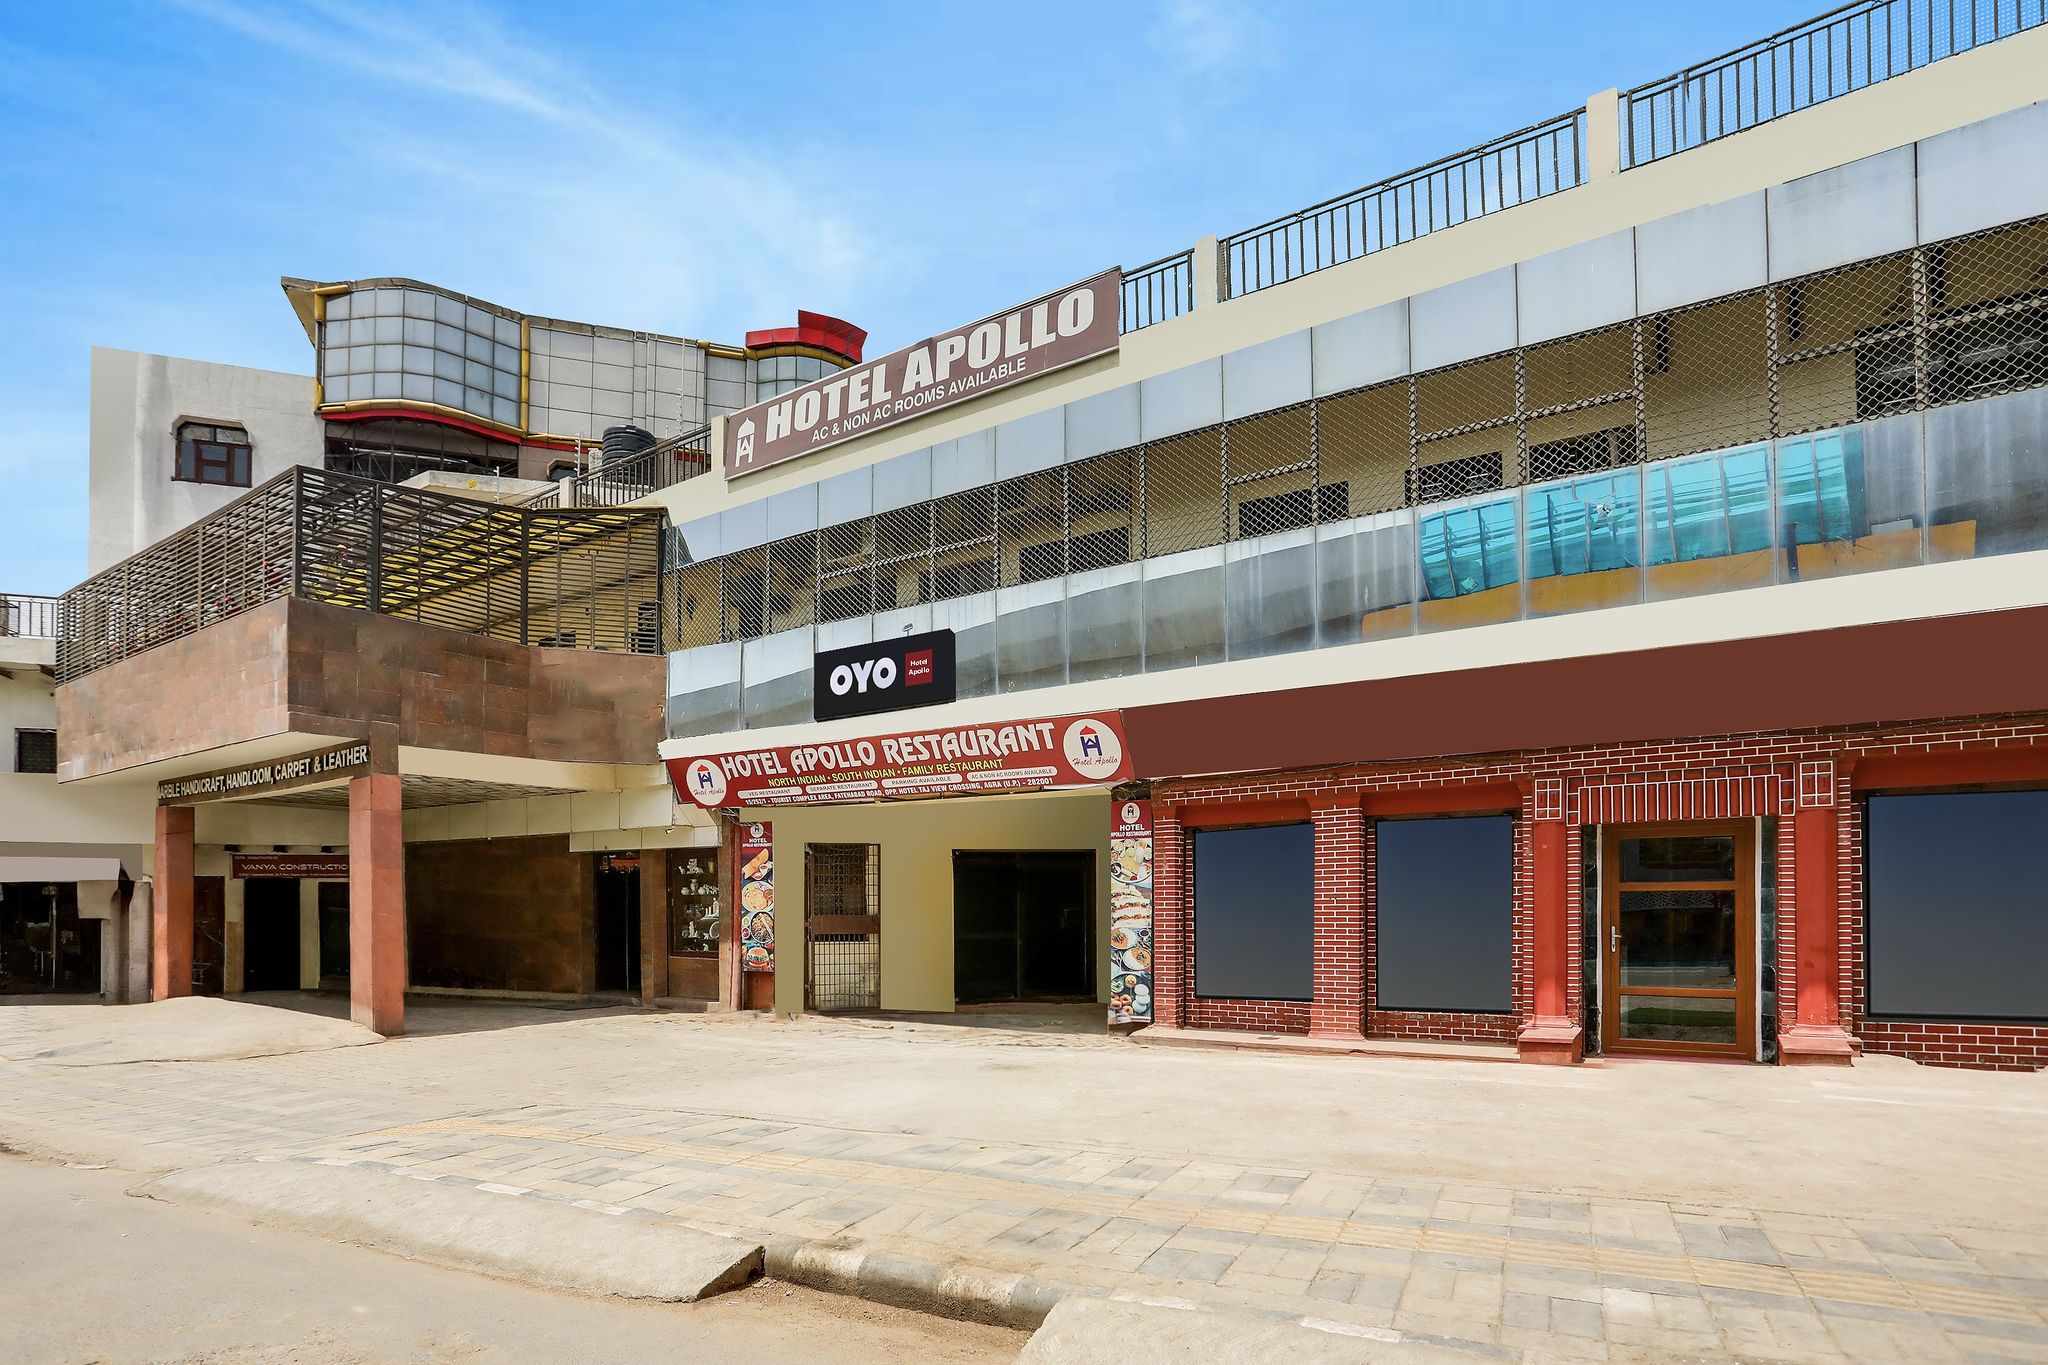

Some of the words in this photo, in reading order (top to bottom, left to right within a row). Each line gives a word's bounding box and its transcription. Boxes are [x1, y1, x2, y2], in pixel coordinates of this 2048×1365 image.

[766, 363, 892, 443] HOTEL
[901, 288, 1094, 396] APOLLO
[811, 425, 829, 443] AC
[831, 422, 840, 435] &
[843, 412, 871, 431] NON
[873, 406, 892, 422] AC
[895, 386, 945, 414] ROOMS
[948, 358, 1026, 396] AVAILABLE
[910, 658, 928, 666] Hotel
[829, 657, 897, 696] OYO
[908, 667, 930, 676] Apollo
[719, 751, 787, 781] HOTEL
[790, 741, 876, 775] APOLLO
[880, 722, 1055, 765] RESTAURANT
[1073, 757, 1092, 766] Hotel
[1094, 756, 1118, 767] Apollo
[180, 775, 226, 797] HANDICRAFT,
[226, 766, 273, 790] HANDLOOM,
[275, 758, 311, 780] CARPET
[313, 755, 321, 773] &
[323, 745, 368, 771] LEATHER
[768, 777, 796, 787] NORTH
[797, 774, 826, 785] INDIAN
[831, 771, 863, 781] SOUTH
[864, 768, 895, 779] INDIAN
[902, 764, 934, 776] FAMILY
[937, 758, 1003, 773] RESTAURANT
[1003, 769, 1023, 778] ROOMS
[1024, 767, 1052, 776] AVAILABLE
[837, 782, 873, 790] RESTAURANT
[891, 778, 918, 786] PARKING
[918, 775, 951, 784] AVAILABLE
[759, 788, 791, 797] RESTAURANT
[771, 796, 793, 804] TOURIST
[793, 794, 818, 802] COMPLEX
[818, 793, 834, 801] AREA,
[834, 790, 866, 800] FATEHABAD
[866, 788, 885, 797] ROAD,
[885, 787, 898, 796] OPP.
[898, 786, 919, 795] HOTEL
[919, 785, 930, 793] TAJ
[930, 783, 948, 792] VIEW
[948, 781, 984, 792] CROSSING,
[984, 780, 1001, 789] AGRA
[1003, 779, 1021, 789] (U.P.)
[1027, 777, 1053, 786] 282001
[278, 863, 348, 871] CONSTRUCTIO
